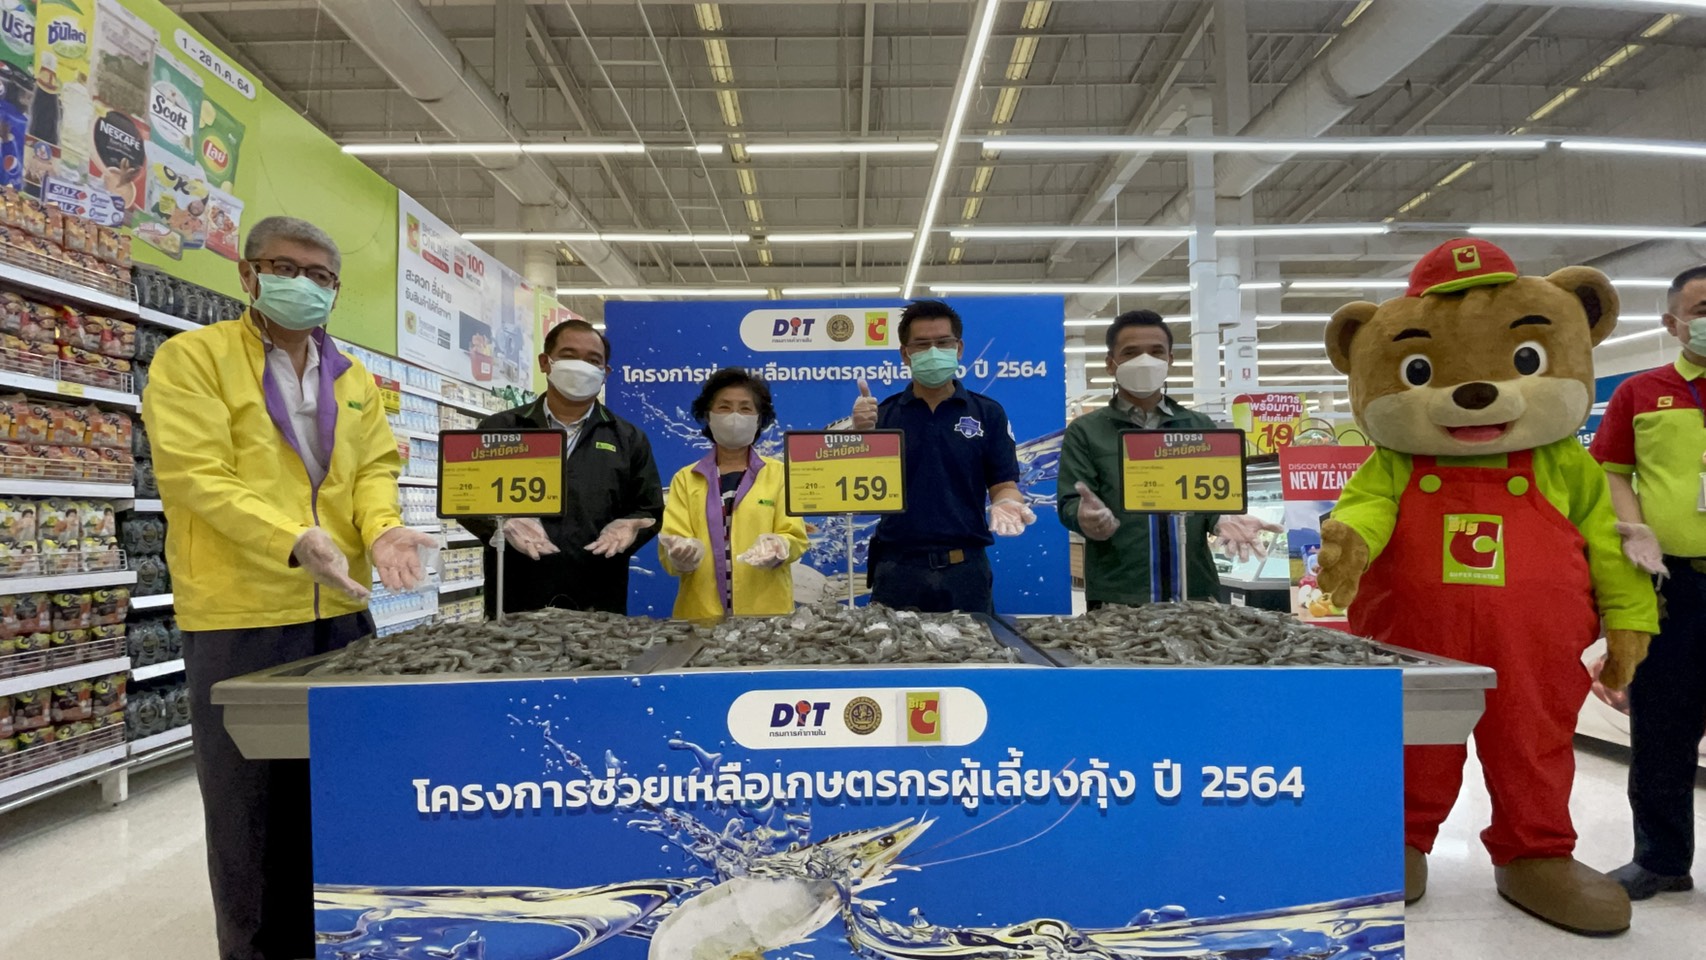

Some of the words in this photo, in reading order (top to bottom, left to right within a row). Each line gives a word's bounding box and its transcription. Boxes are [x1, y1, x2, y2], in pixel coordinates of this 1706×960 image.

[182, 37, 188, 49] 1
[199, 50, 212, 67] 28
[237, 78, 249, 94] 64
[152, 95, 188, 130] Scott
[52, 185, 77, 197] SALZ
[58, 201, 76, 213] ALZ
[467, 254, 485, 277] 100
[974, 358, 988, 378] ปี
[997, 361, 1047, 378] 2564
[1250, 400, 1303, 413] พร้อมทาน
[1267, 394, 1300, 404] อาหาร
[1262, 424, 1292, 448] 19
[471, 444, 529, 460] ประหยัดจริง
[815, 445, 870, 459] ประหยัดจริง
[1154, 443, 1212, 457] ประหยัดจริง
[491, 477, 546, 503] 159
[835, 475, 888, 502] 159
[1175, 475, 1230, 500] 159
[1290, 471, 1318, 490] NEW
[1472, 572, 1500, 580] CENTER
[908, 697, 926, 711] Big
[909, 700, 939, 735] C
[412, 747, 1137, 813] โครงการช่วยเหลือเกษตรกรผู้เลี้ยงกุ้ง
[1153, 759, 1182, 798] ปี
[1201, 765, 1306, 799] 2564
